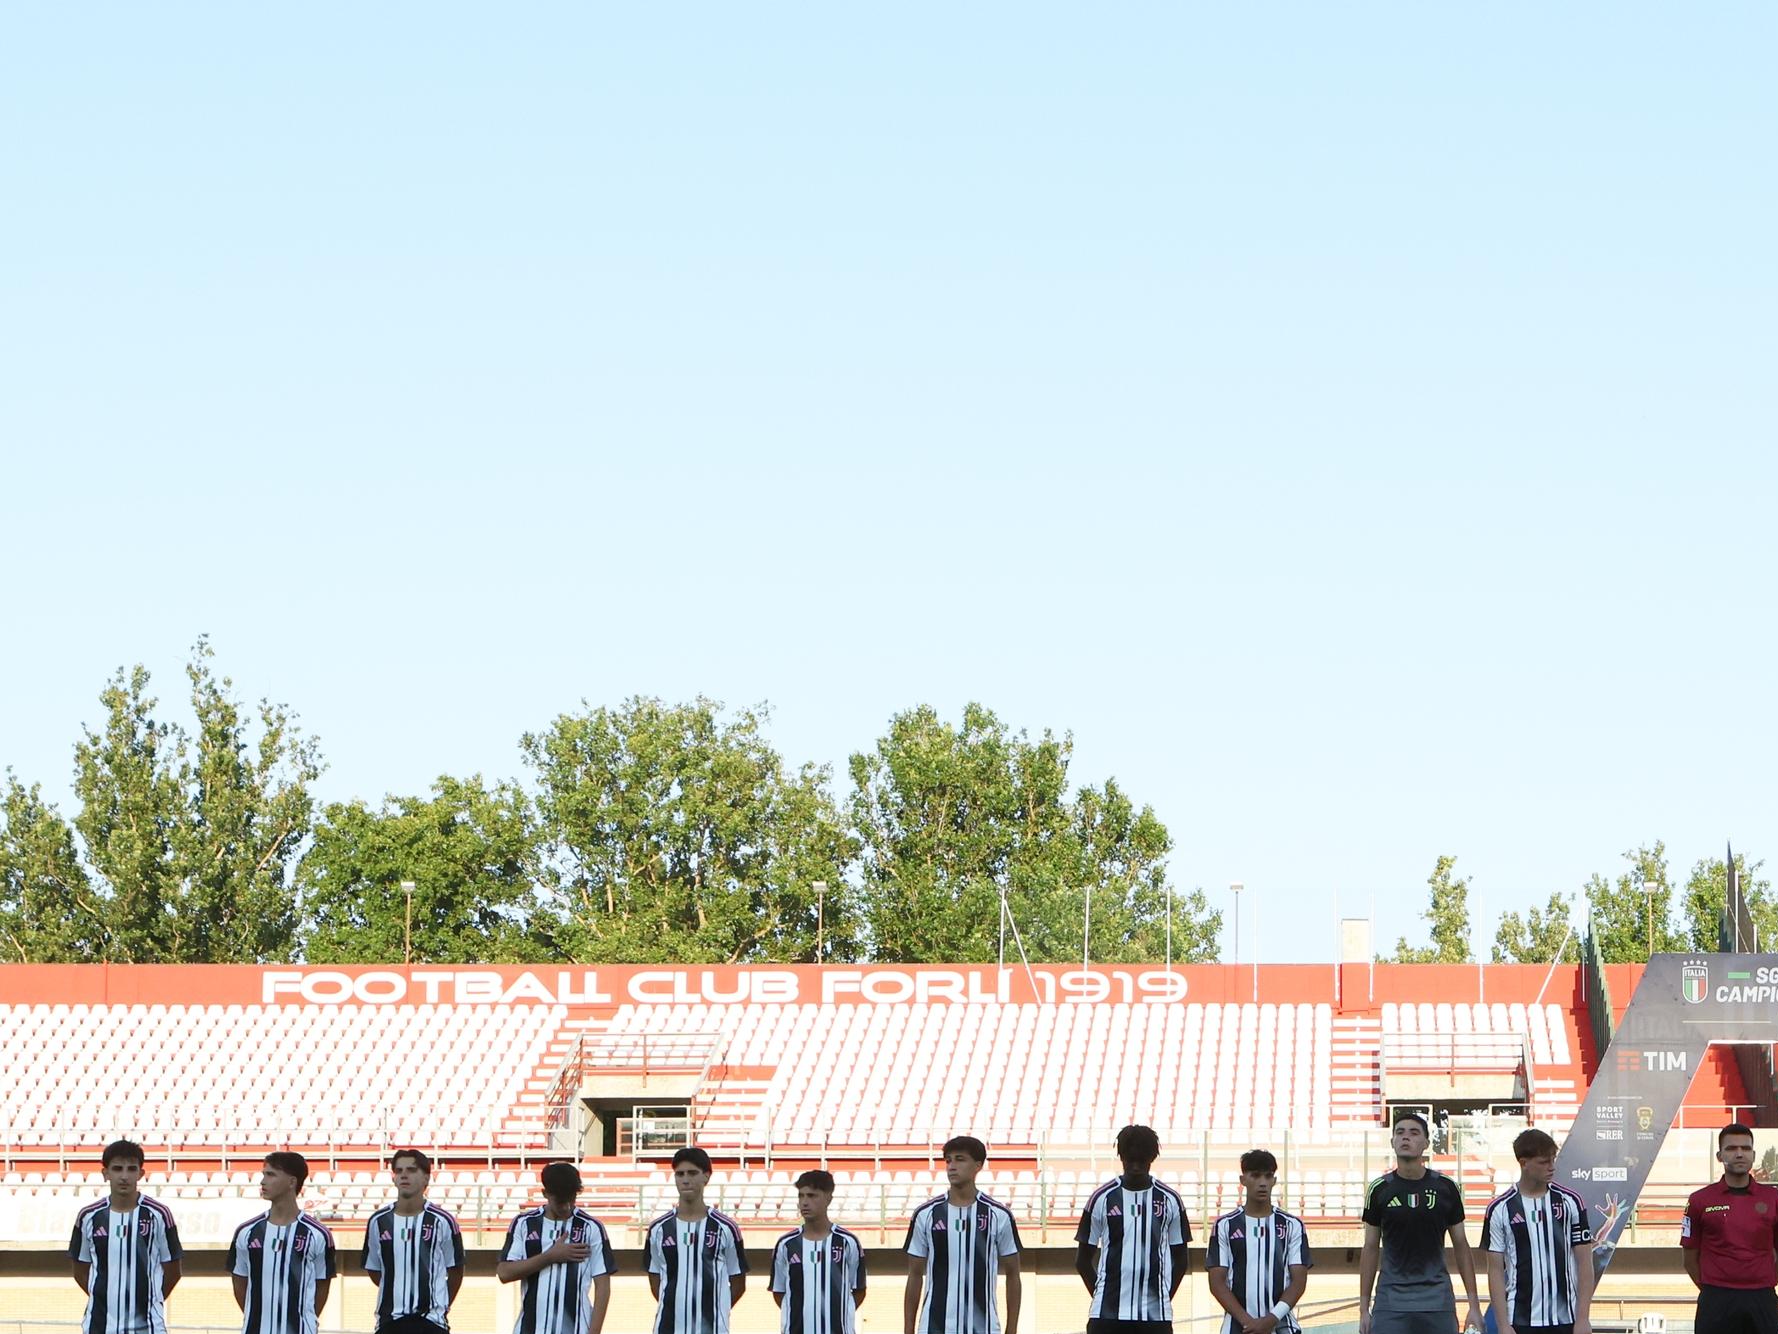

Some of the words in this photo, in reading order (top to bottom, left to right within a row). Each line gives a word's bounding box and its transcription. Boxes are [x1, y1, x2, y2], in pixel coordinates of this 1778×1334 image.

[262, 971, 611, 1004] FOOTBALL
[627, 971, 799, 1004] CLUB
[1035, 971, 1188, 1003] 1919
[1643, 1051, 1687, 1071] TIM
[1571, 1168, 1591, 1180] sky
[1594, 1168, 1625, 1179] sport
[1581, 1229, 1590, 1242] C
